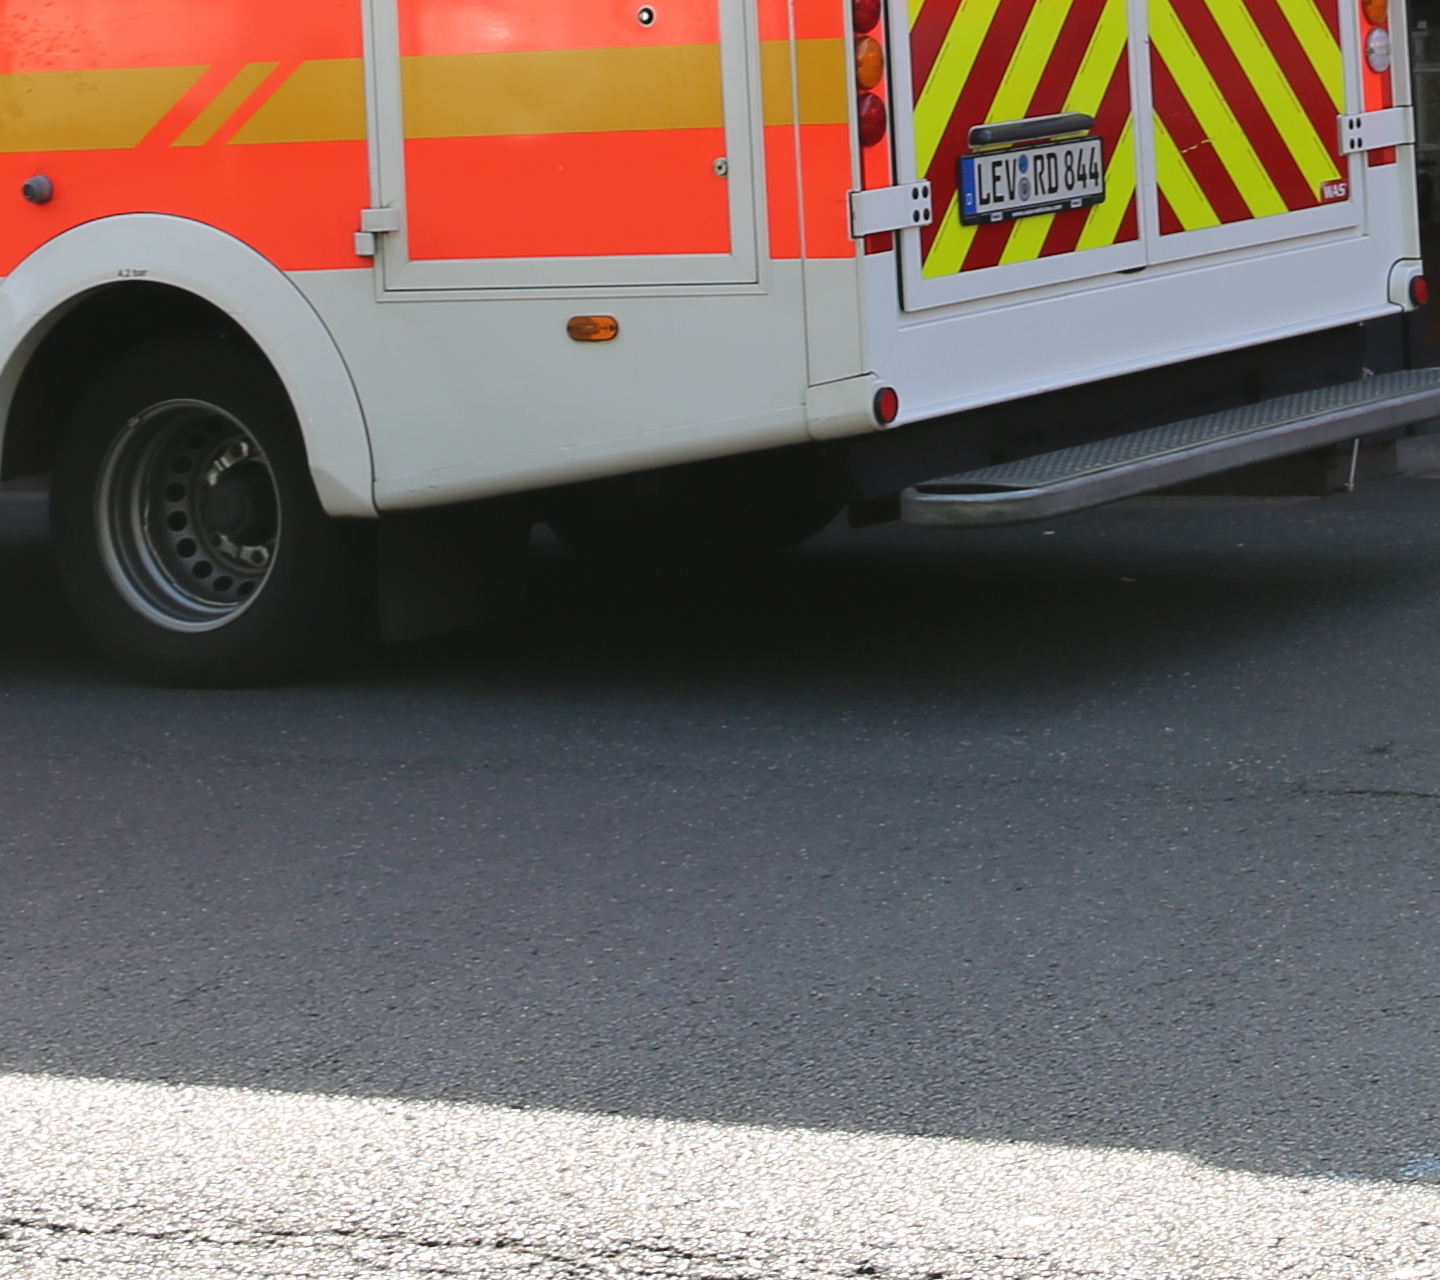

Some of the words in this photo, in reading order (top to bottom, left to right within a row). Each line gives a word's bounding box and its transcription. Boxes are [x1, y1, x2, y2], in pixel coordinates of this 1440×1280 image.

[977, 159, 1017, 205] LEV
[1034, 152, 1058, 196] RD
[1064, 146, 1099, 190] 844
[1322, 183, 1347, 199] WAS
